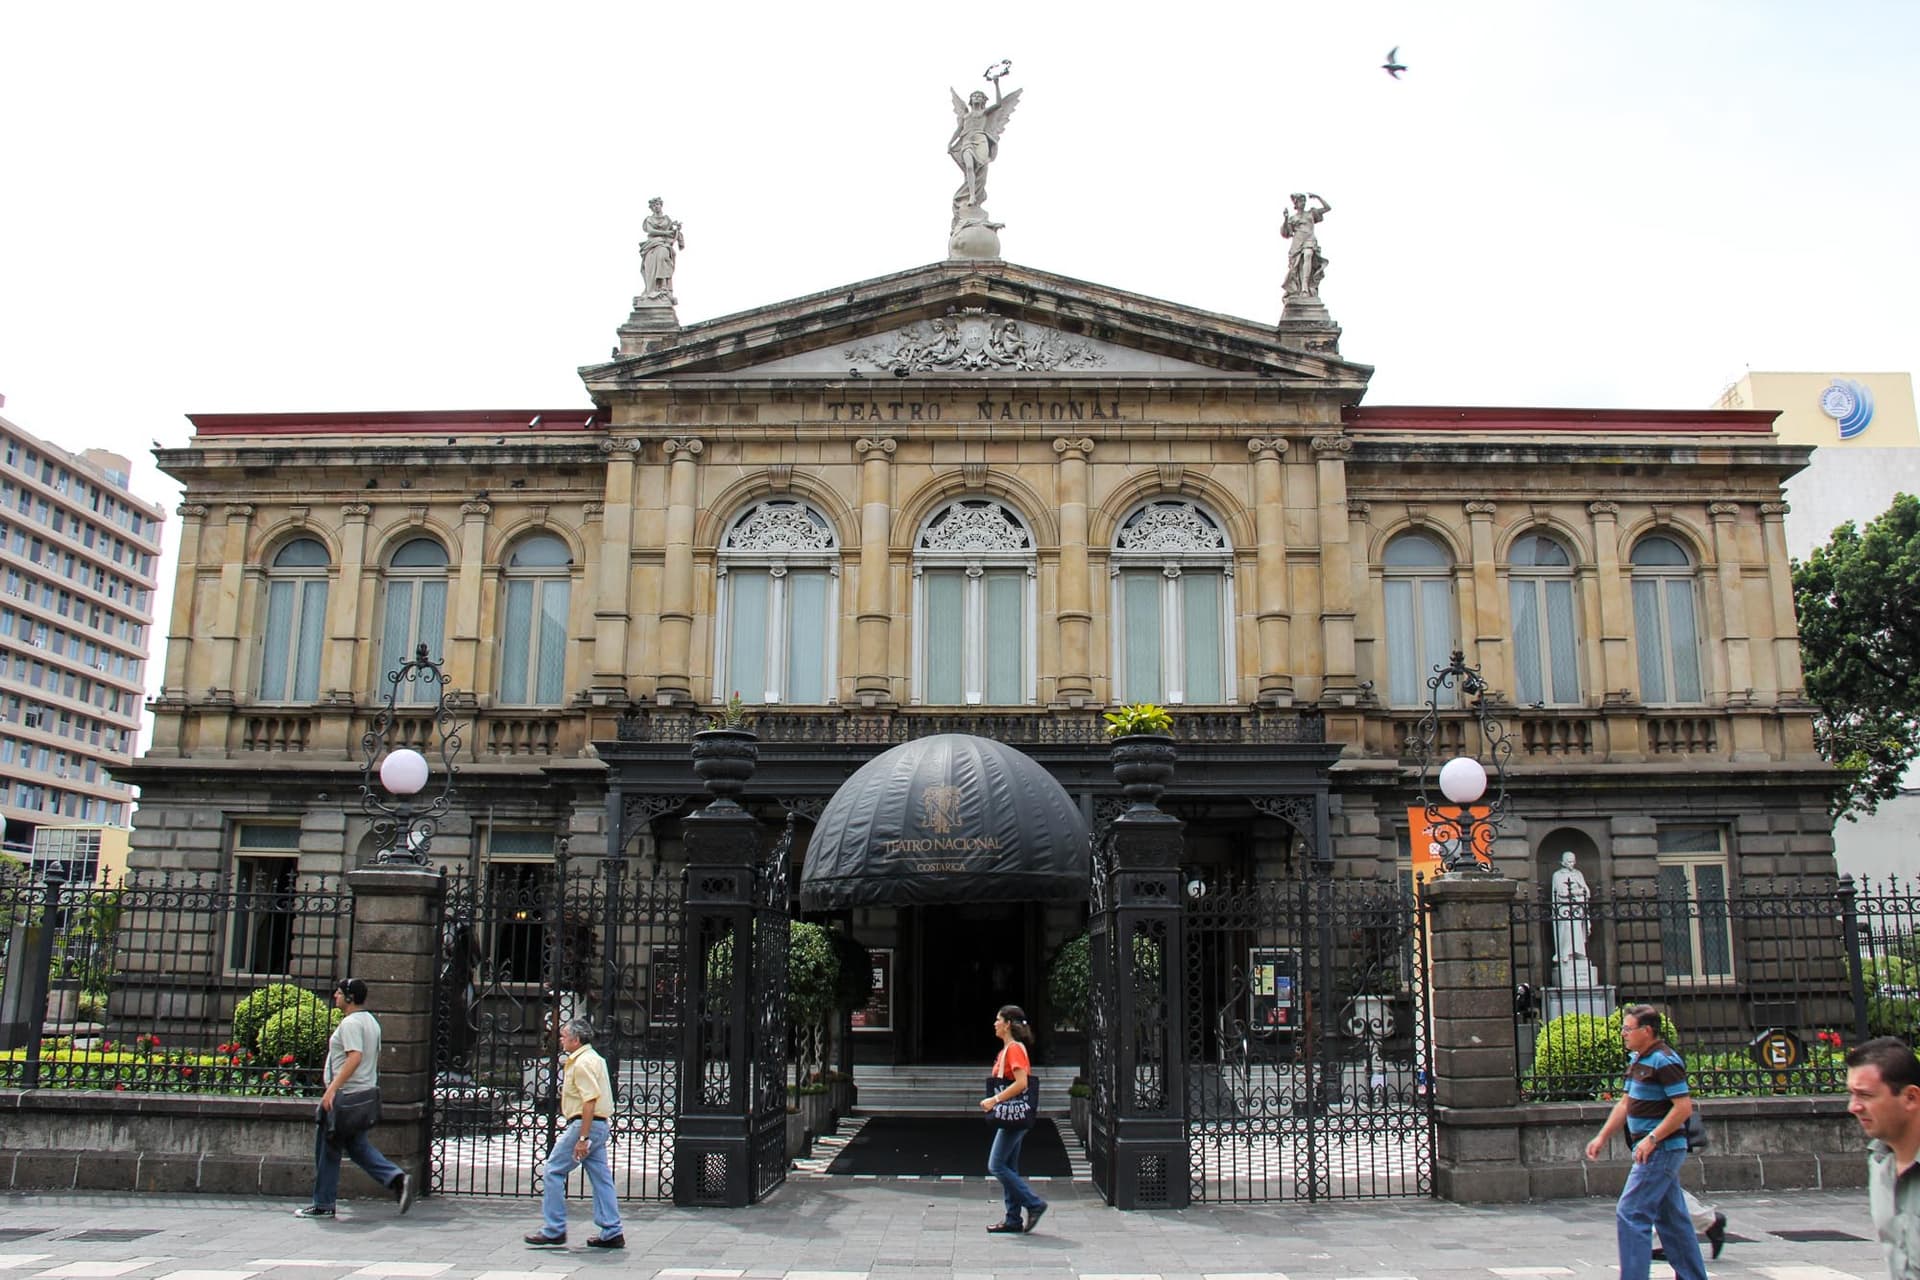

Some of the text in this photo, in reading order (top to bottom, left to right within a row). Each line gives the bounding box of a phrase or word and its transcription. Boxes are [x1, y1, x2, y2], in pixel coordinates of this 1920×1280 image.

[828, 402, 1126, 420] TEATRO NACIONAL
[881, 837, 1003, 852] TEATRO NACIONAL
